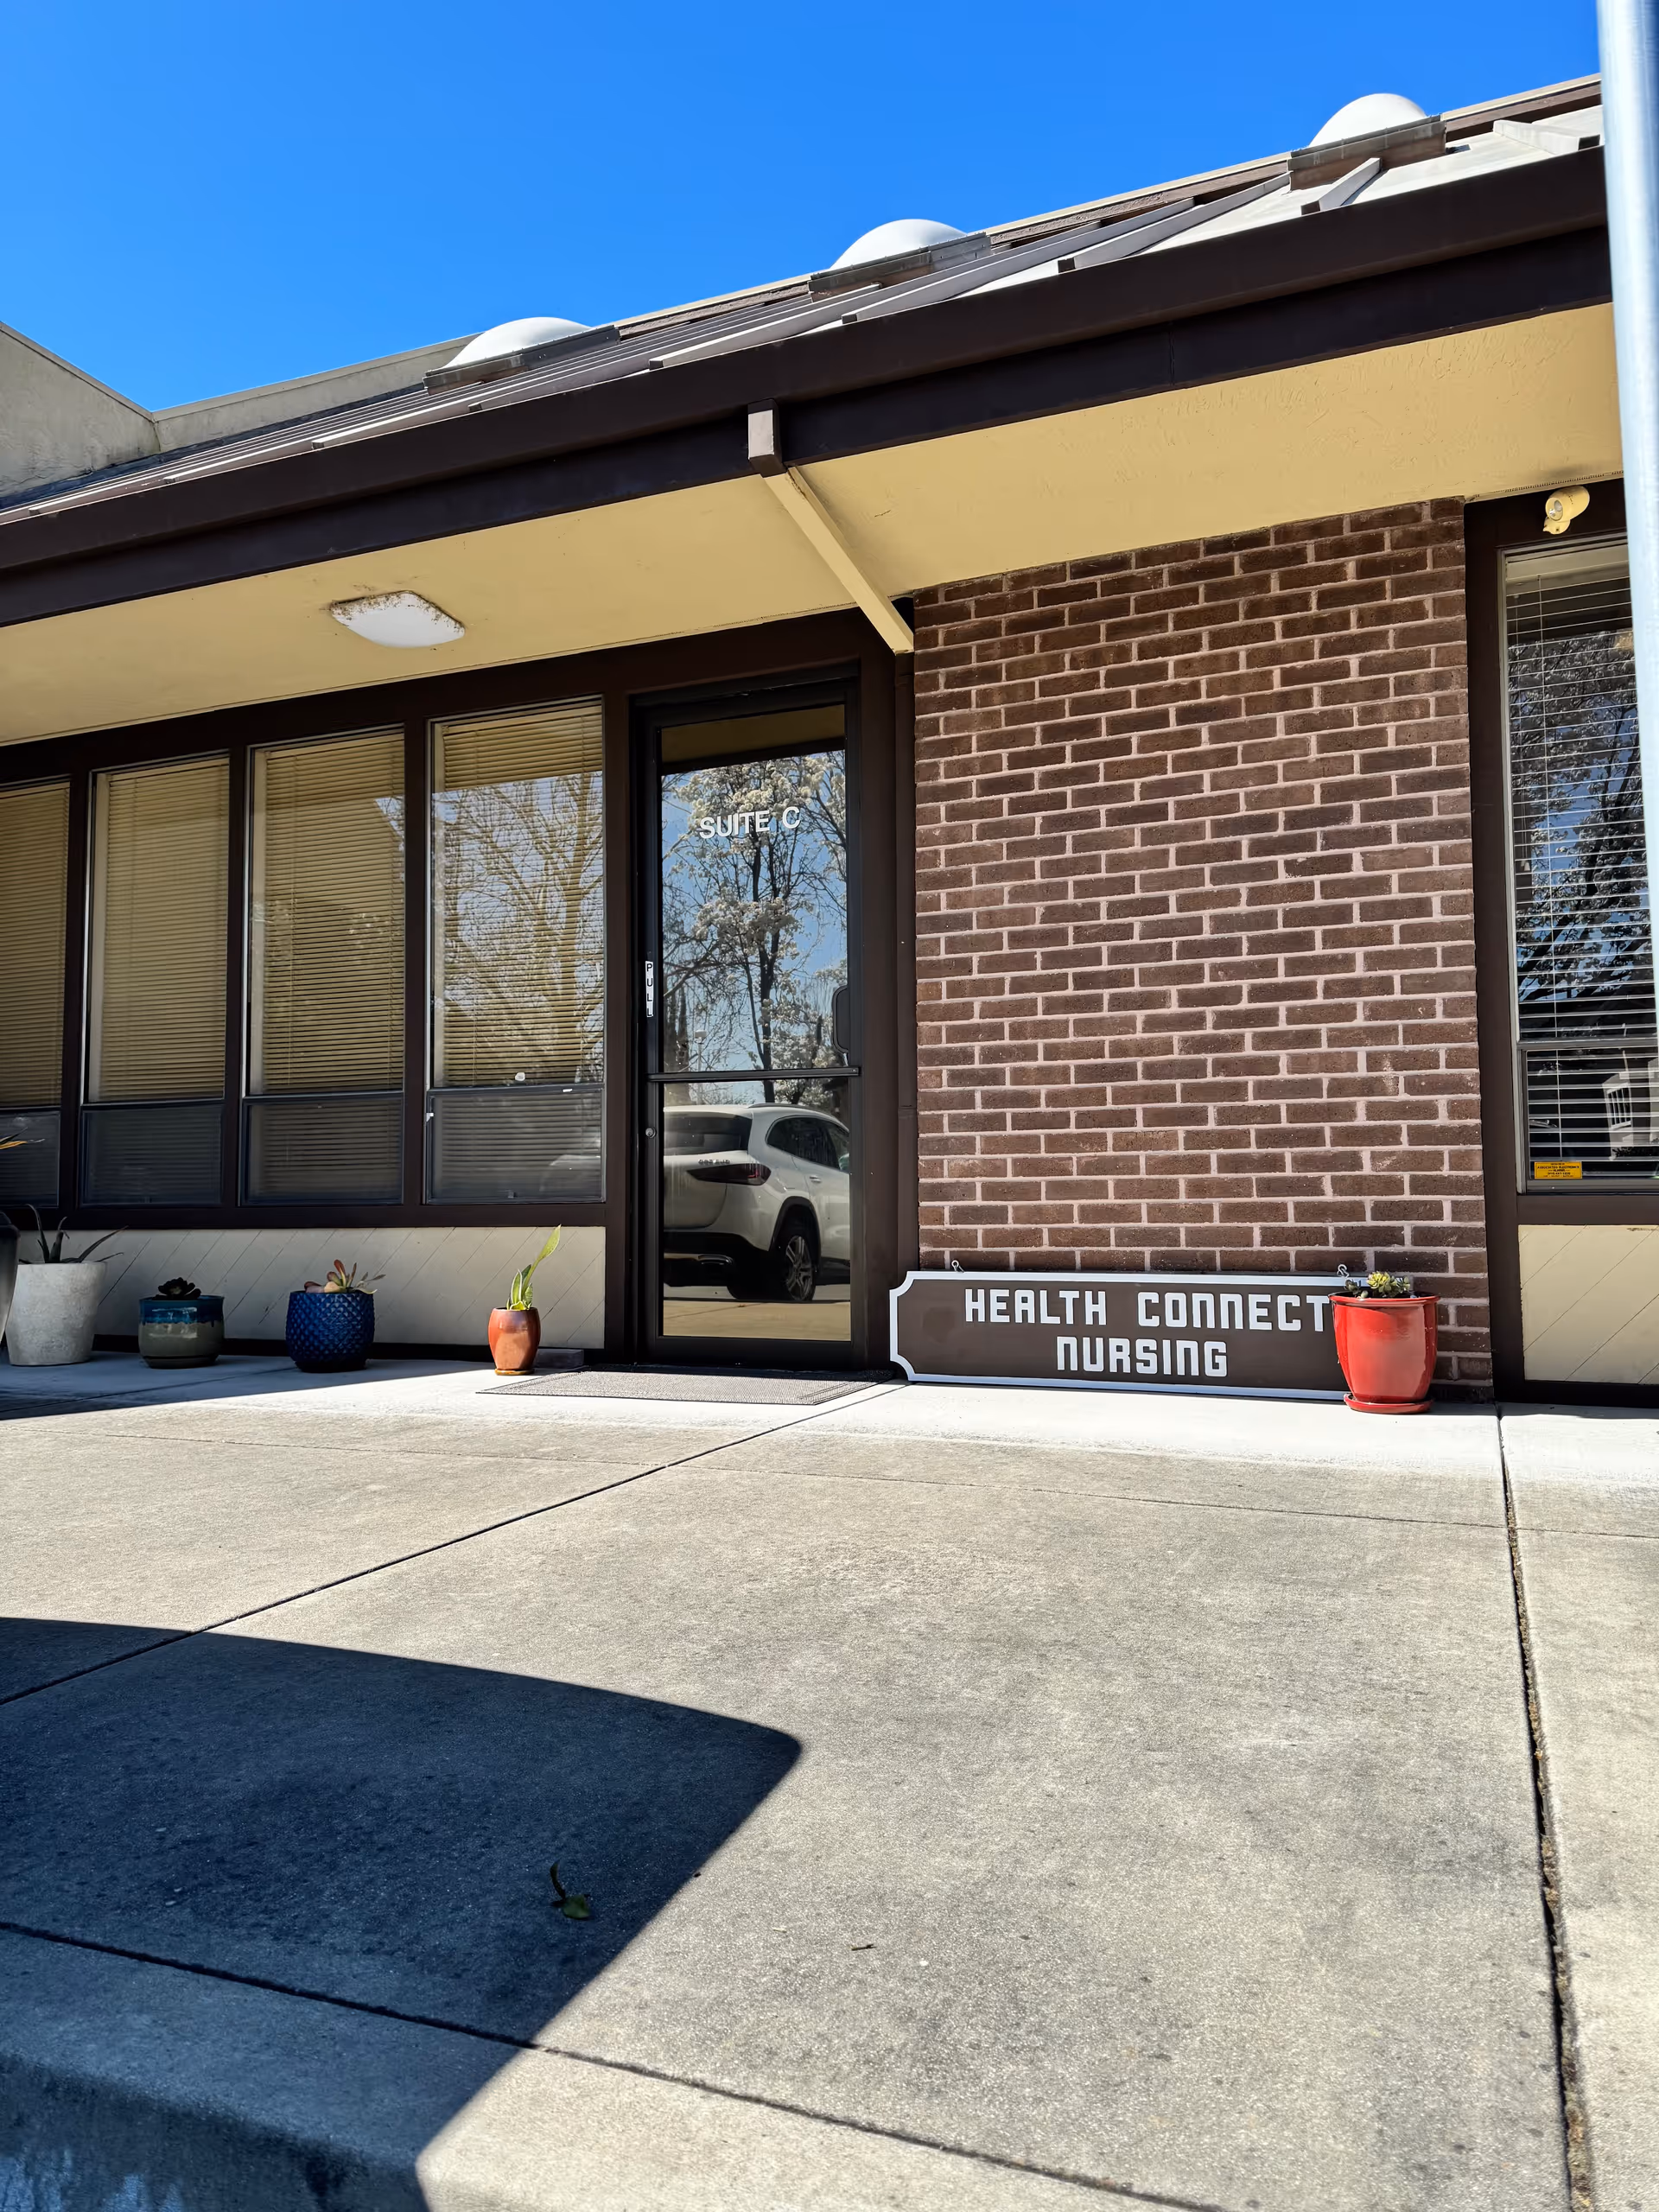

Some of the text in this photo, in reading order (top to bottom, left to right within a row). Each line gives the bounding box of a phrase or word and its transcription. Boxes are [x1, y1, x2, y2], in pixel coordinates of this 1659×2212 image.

[699, 806, 801, 839] SUITE C
[965, 1288, 1330, 1332] HEALTH CONNECT
[1057, 1336, 1227, 1377] NURSING
